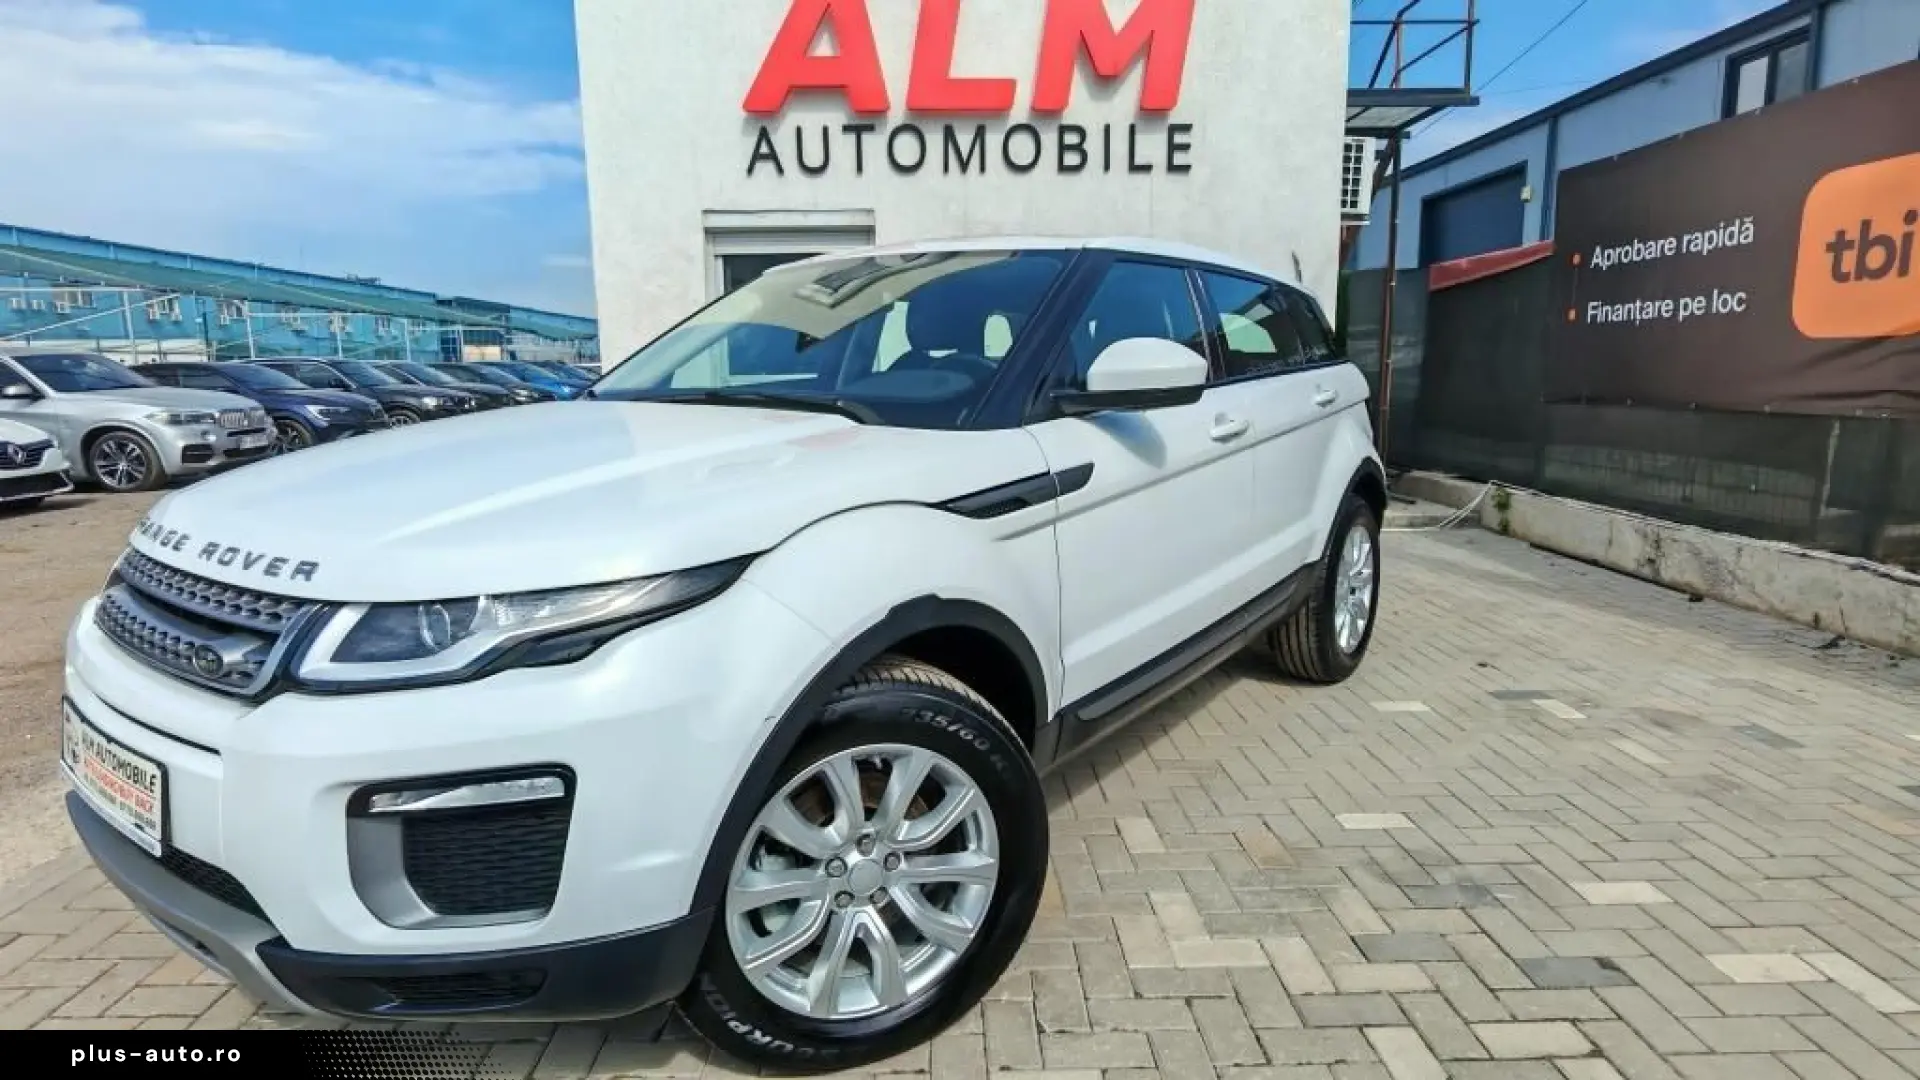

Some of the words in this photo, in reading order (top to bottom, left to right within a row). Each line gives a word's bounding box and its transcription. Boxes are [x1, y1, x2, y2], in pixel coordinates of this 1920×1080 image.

[741, 0, 1197, 114] ALM
[746, 122, 1194, 176] AUTOMOBILE
[1590, 236, 1678, 271] Aprobare
[1682, 216, 1755, 256] rapidă
[1825, 209, 1918, 284] tbi
[1587, 299, 1675, 326] Finanțare
[1678, 295, 1705, 323] pe
[1711, 288, 1748, 315] loc
[199, 541, 320, 582] ROVER
[96, 741, 157, 794] AUTOMOBILE
